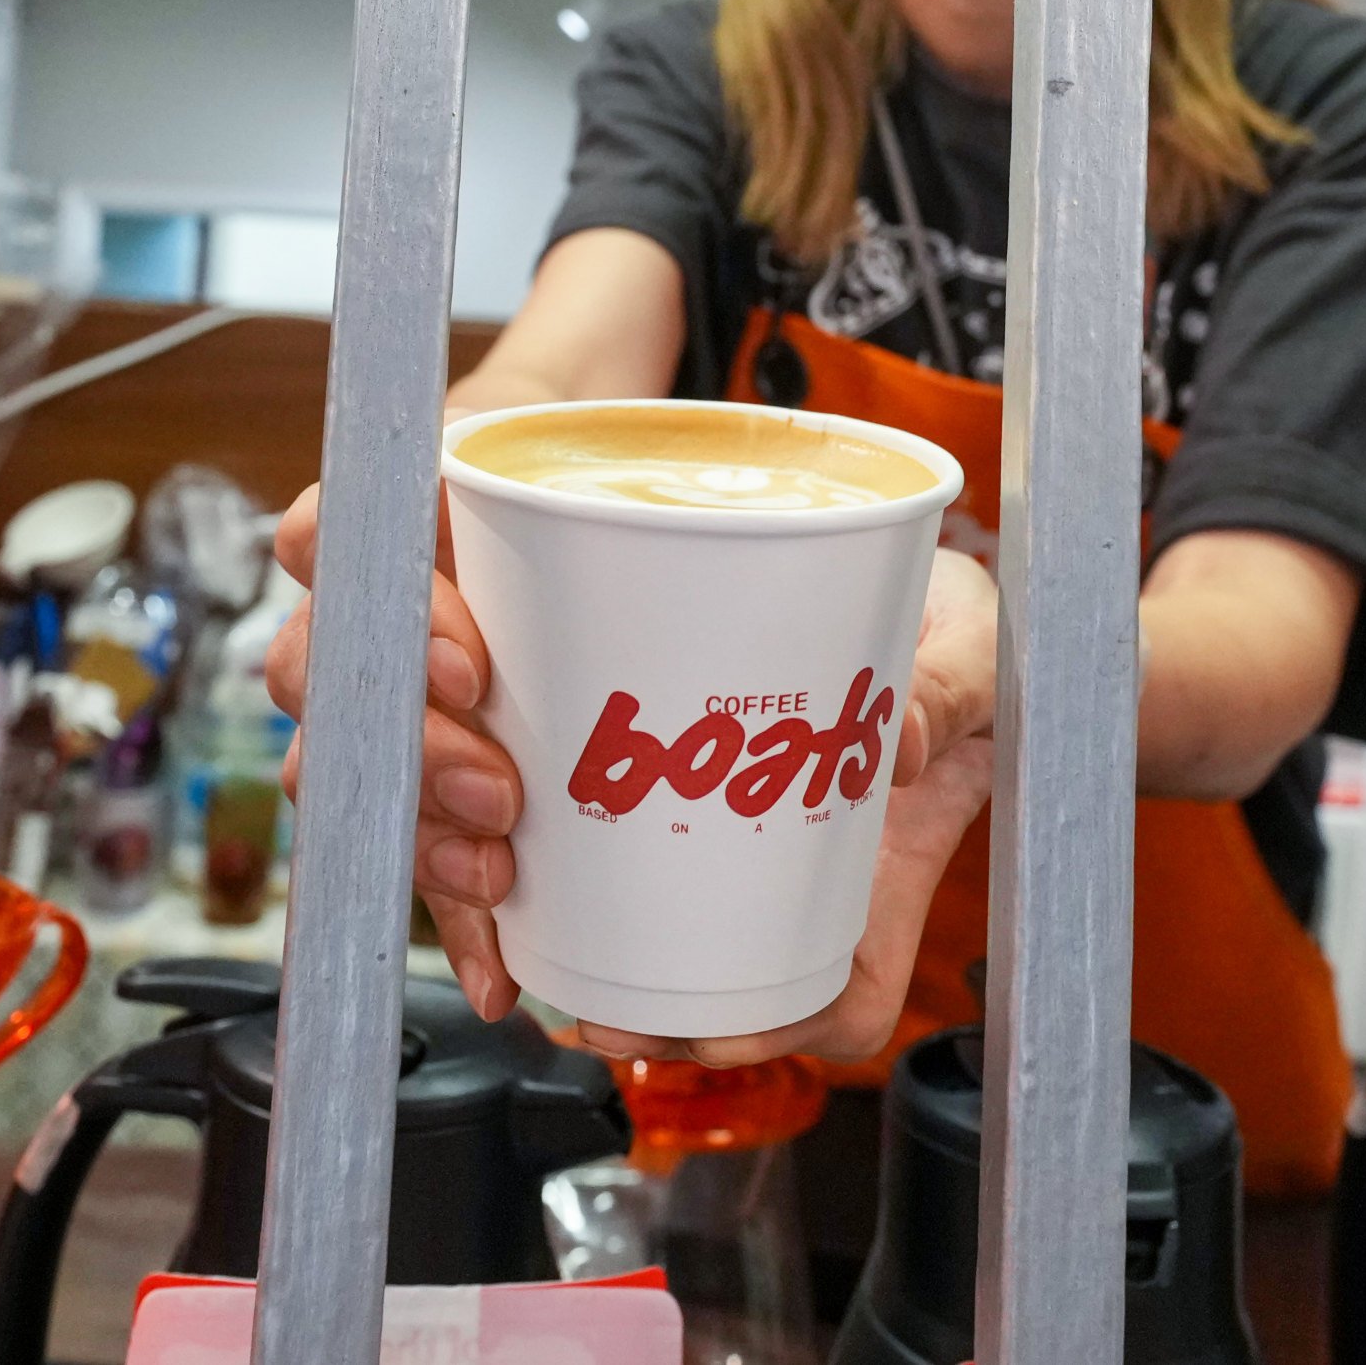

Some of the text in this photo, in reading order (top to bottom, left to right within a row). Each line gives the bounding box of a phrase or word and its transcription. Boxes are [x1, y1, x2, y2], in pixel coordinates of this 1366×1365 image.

[704, 691, 809, 716] COFFEE
[567, 666, 896, 824] boats
[577, 804, 618, 824] BASED
[671, 822, 690, 834] ON
[755, 822, 764, 834] A
[804, 809, 832, 826] TRUE
